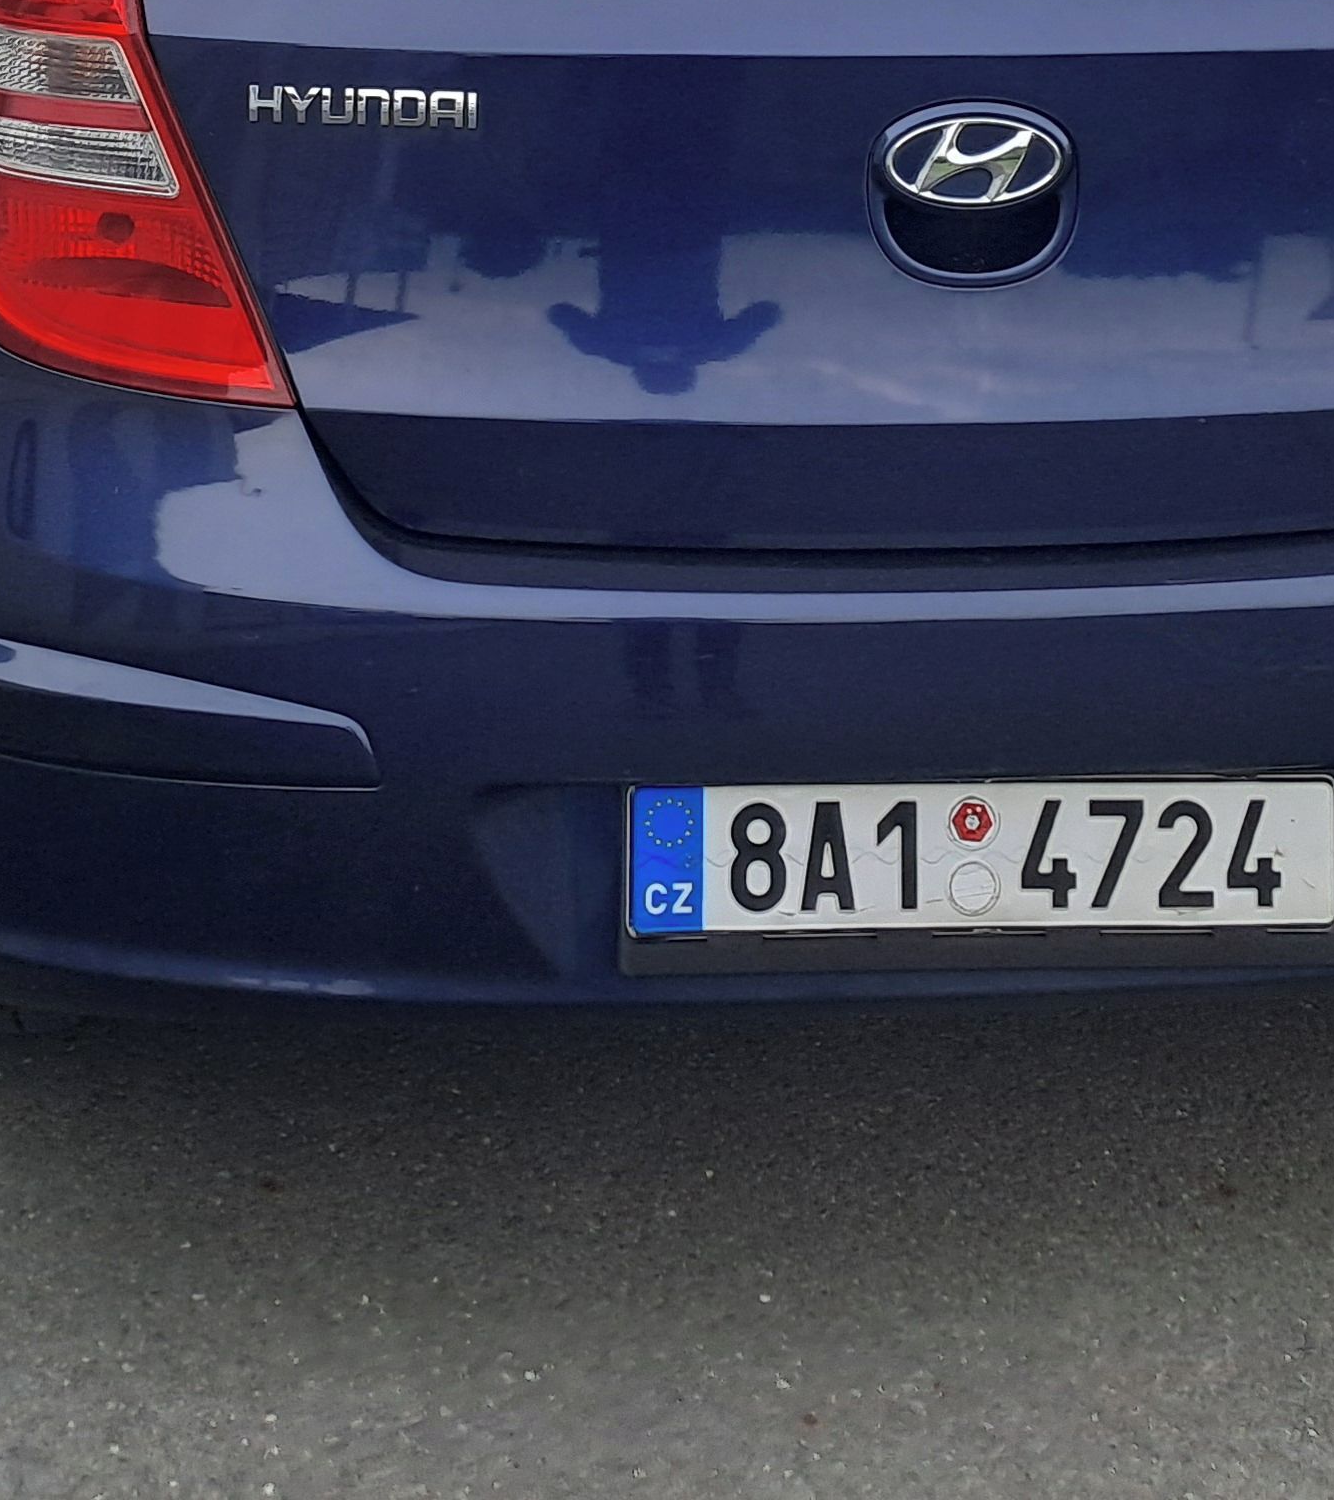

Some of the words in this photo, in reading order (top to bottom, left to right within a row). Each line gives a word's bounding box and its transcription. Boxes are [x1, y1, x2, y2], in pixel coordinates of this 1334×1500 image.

[248, 84, 478, 130] HYUNDAI
[730, 801, 918, 912] 8A1
[1021, 800, 1282, 908] 4724
[645, 882, 694, 915] CZ
